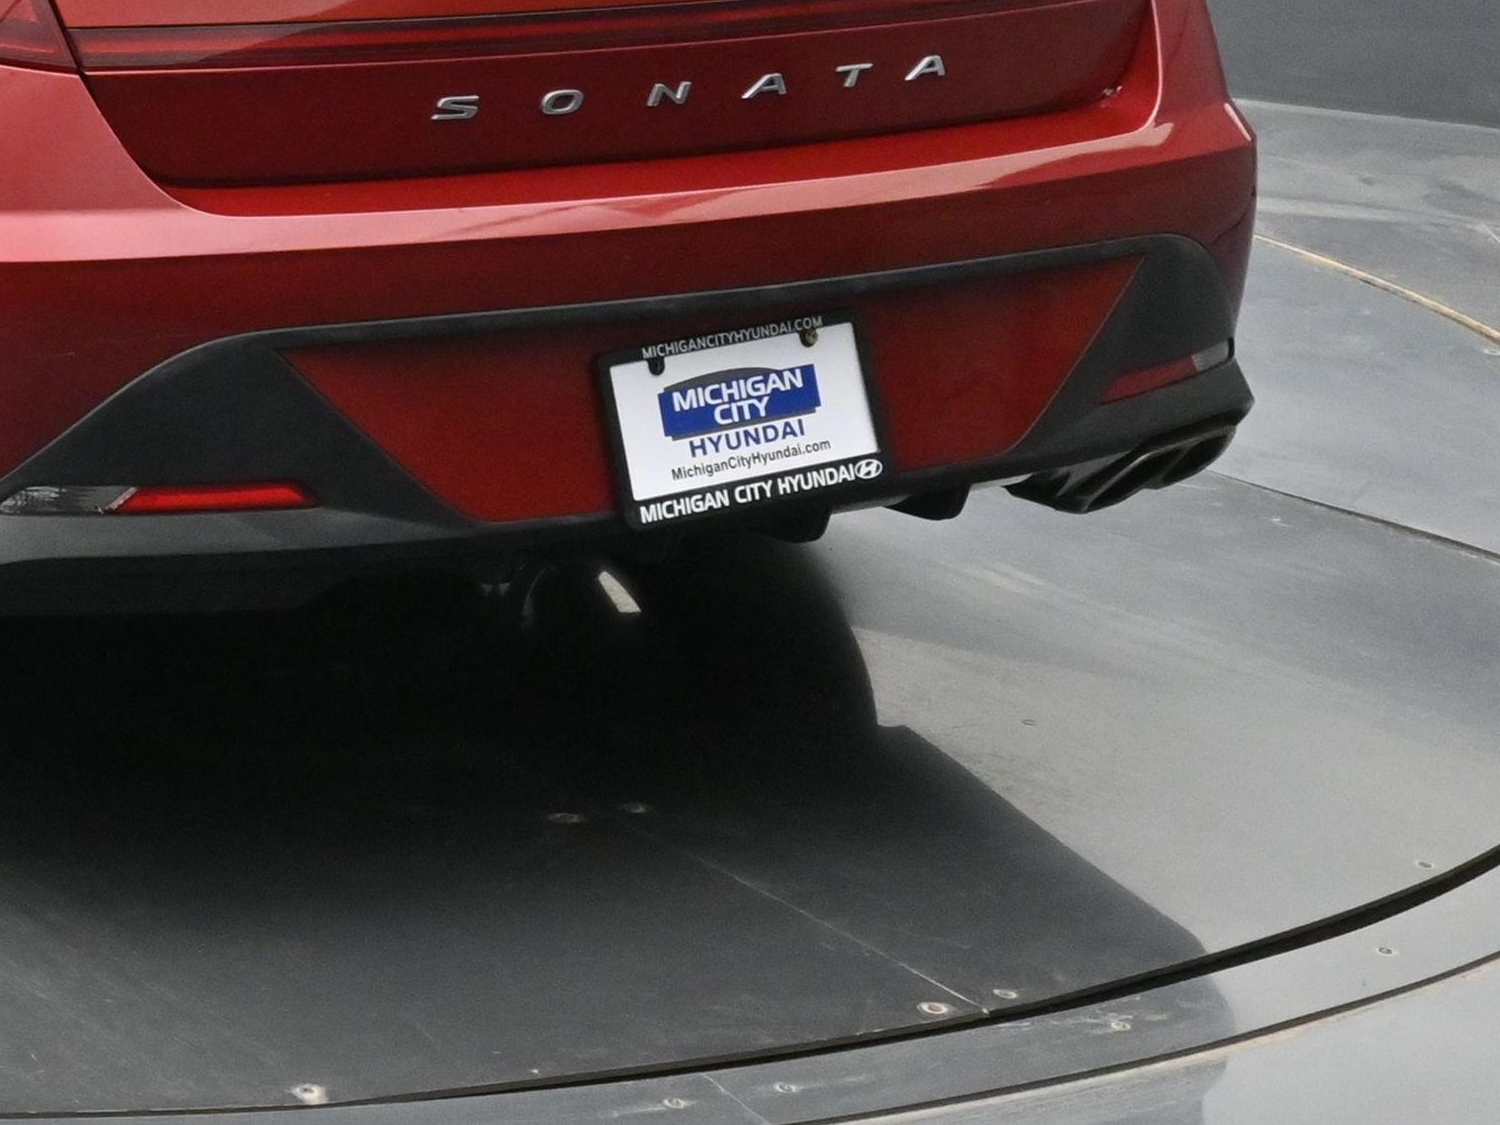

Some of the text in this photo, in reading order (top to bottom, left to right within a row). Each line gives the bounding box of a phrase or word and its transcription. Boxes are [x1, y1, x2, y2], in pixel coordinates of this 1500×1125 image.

[431, 54, 947, 121] SONATA
[641, 315, 823, 359] MICHIGANCITYHYUNDAI.COM
[672, 368, 803, 412] MICHIGAN
[713, 396, 770, 425] CITY
[671, 438, 831, 481] MichiganCityHyundai.com
[688, 419, 806, 458] HYUNDAI
[639, 463, 856, 524] MICHIGAN CITY HYUNDAI
